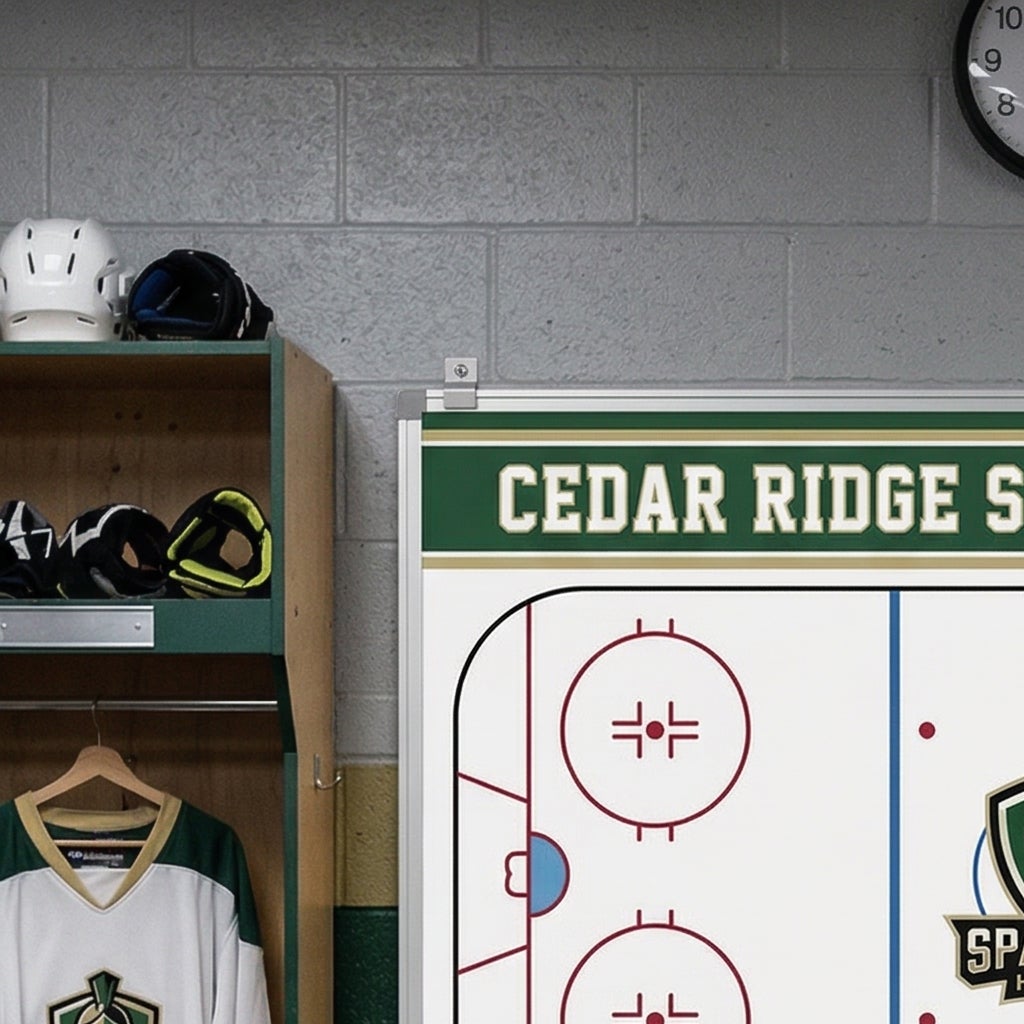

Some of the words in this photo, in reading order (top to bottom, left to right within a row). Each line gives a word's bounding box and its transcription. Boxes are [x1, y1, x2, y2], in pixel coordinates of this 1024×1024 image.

[995, 6, 1023, 30] 10
[984, 49, 1002, 72] 9
[997, 93, 1015, 116] 8
[499, 463, 727, 534] CEDAR
[753, 463, 960, 534] RIDGE
